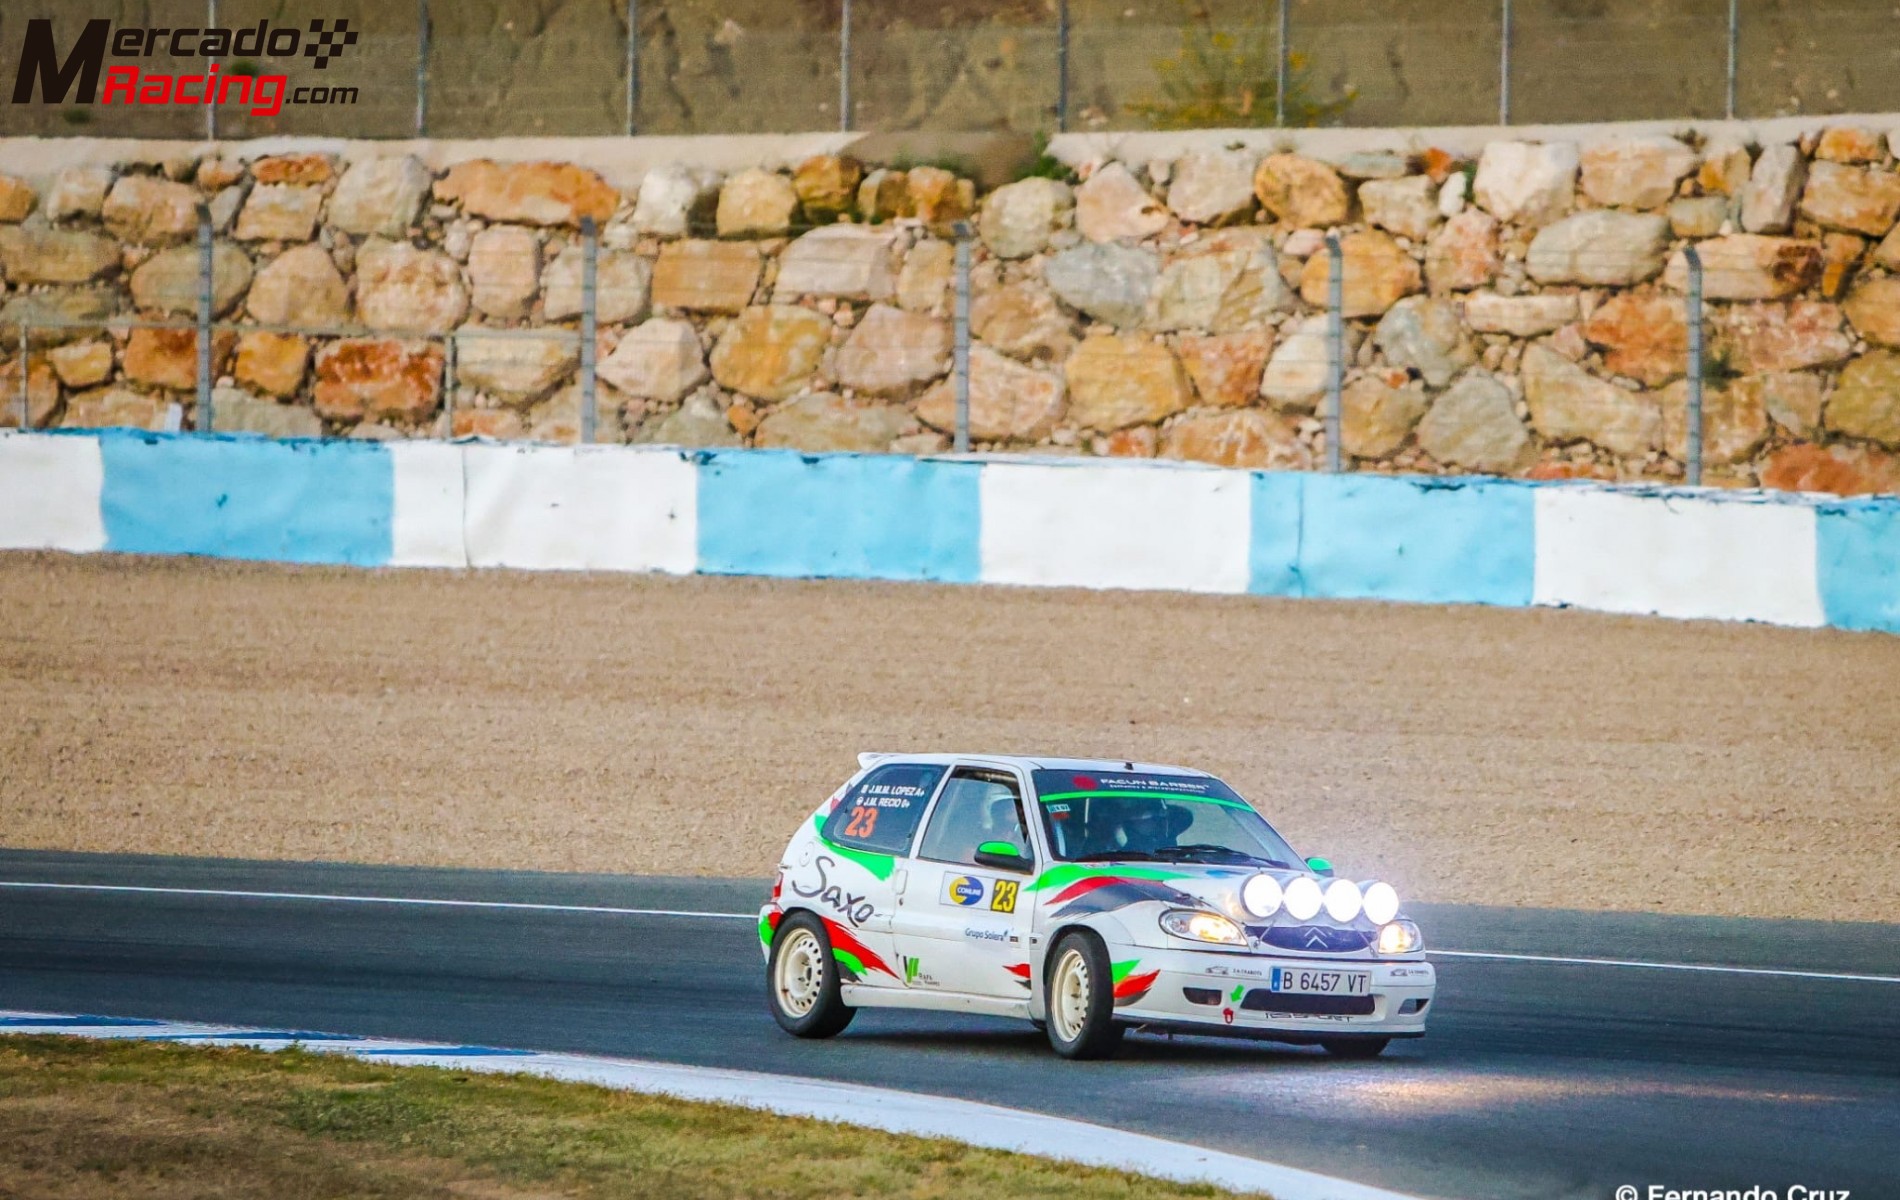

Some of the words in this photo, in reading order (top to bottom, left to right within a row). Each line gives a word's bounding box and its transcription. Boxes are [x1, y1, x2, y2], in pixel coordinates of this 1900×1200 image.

[891, 785, 917, 796] LOPEZ
[878, 797, 901, 808] RECIO
[844, 806, 878, 838] 23
[791, 855, 875, 929] Saxo
[992, 880, 1018, 913] 23
[965, 927, 985, 939] Grupo
[984, 930, 1004, 941] Solera
[1283, 971, 1293, 990] B
[1300, 972, 1341, 992] 6457
[1347, 974, 1367, 993] VT
